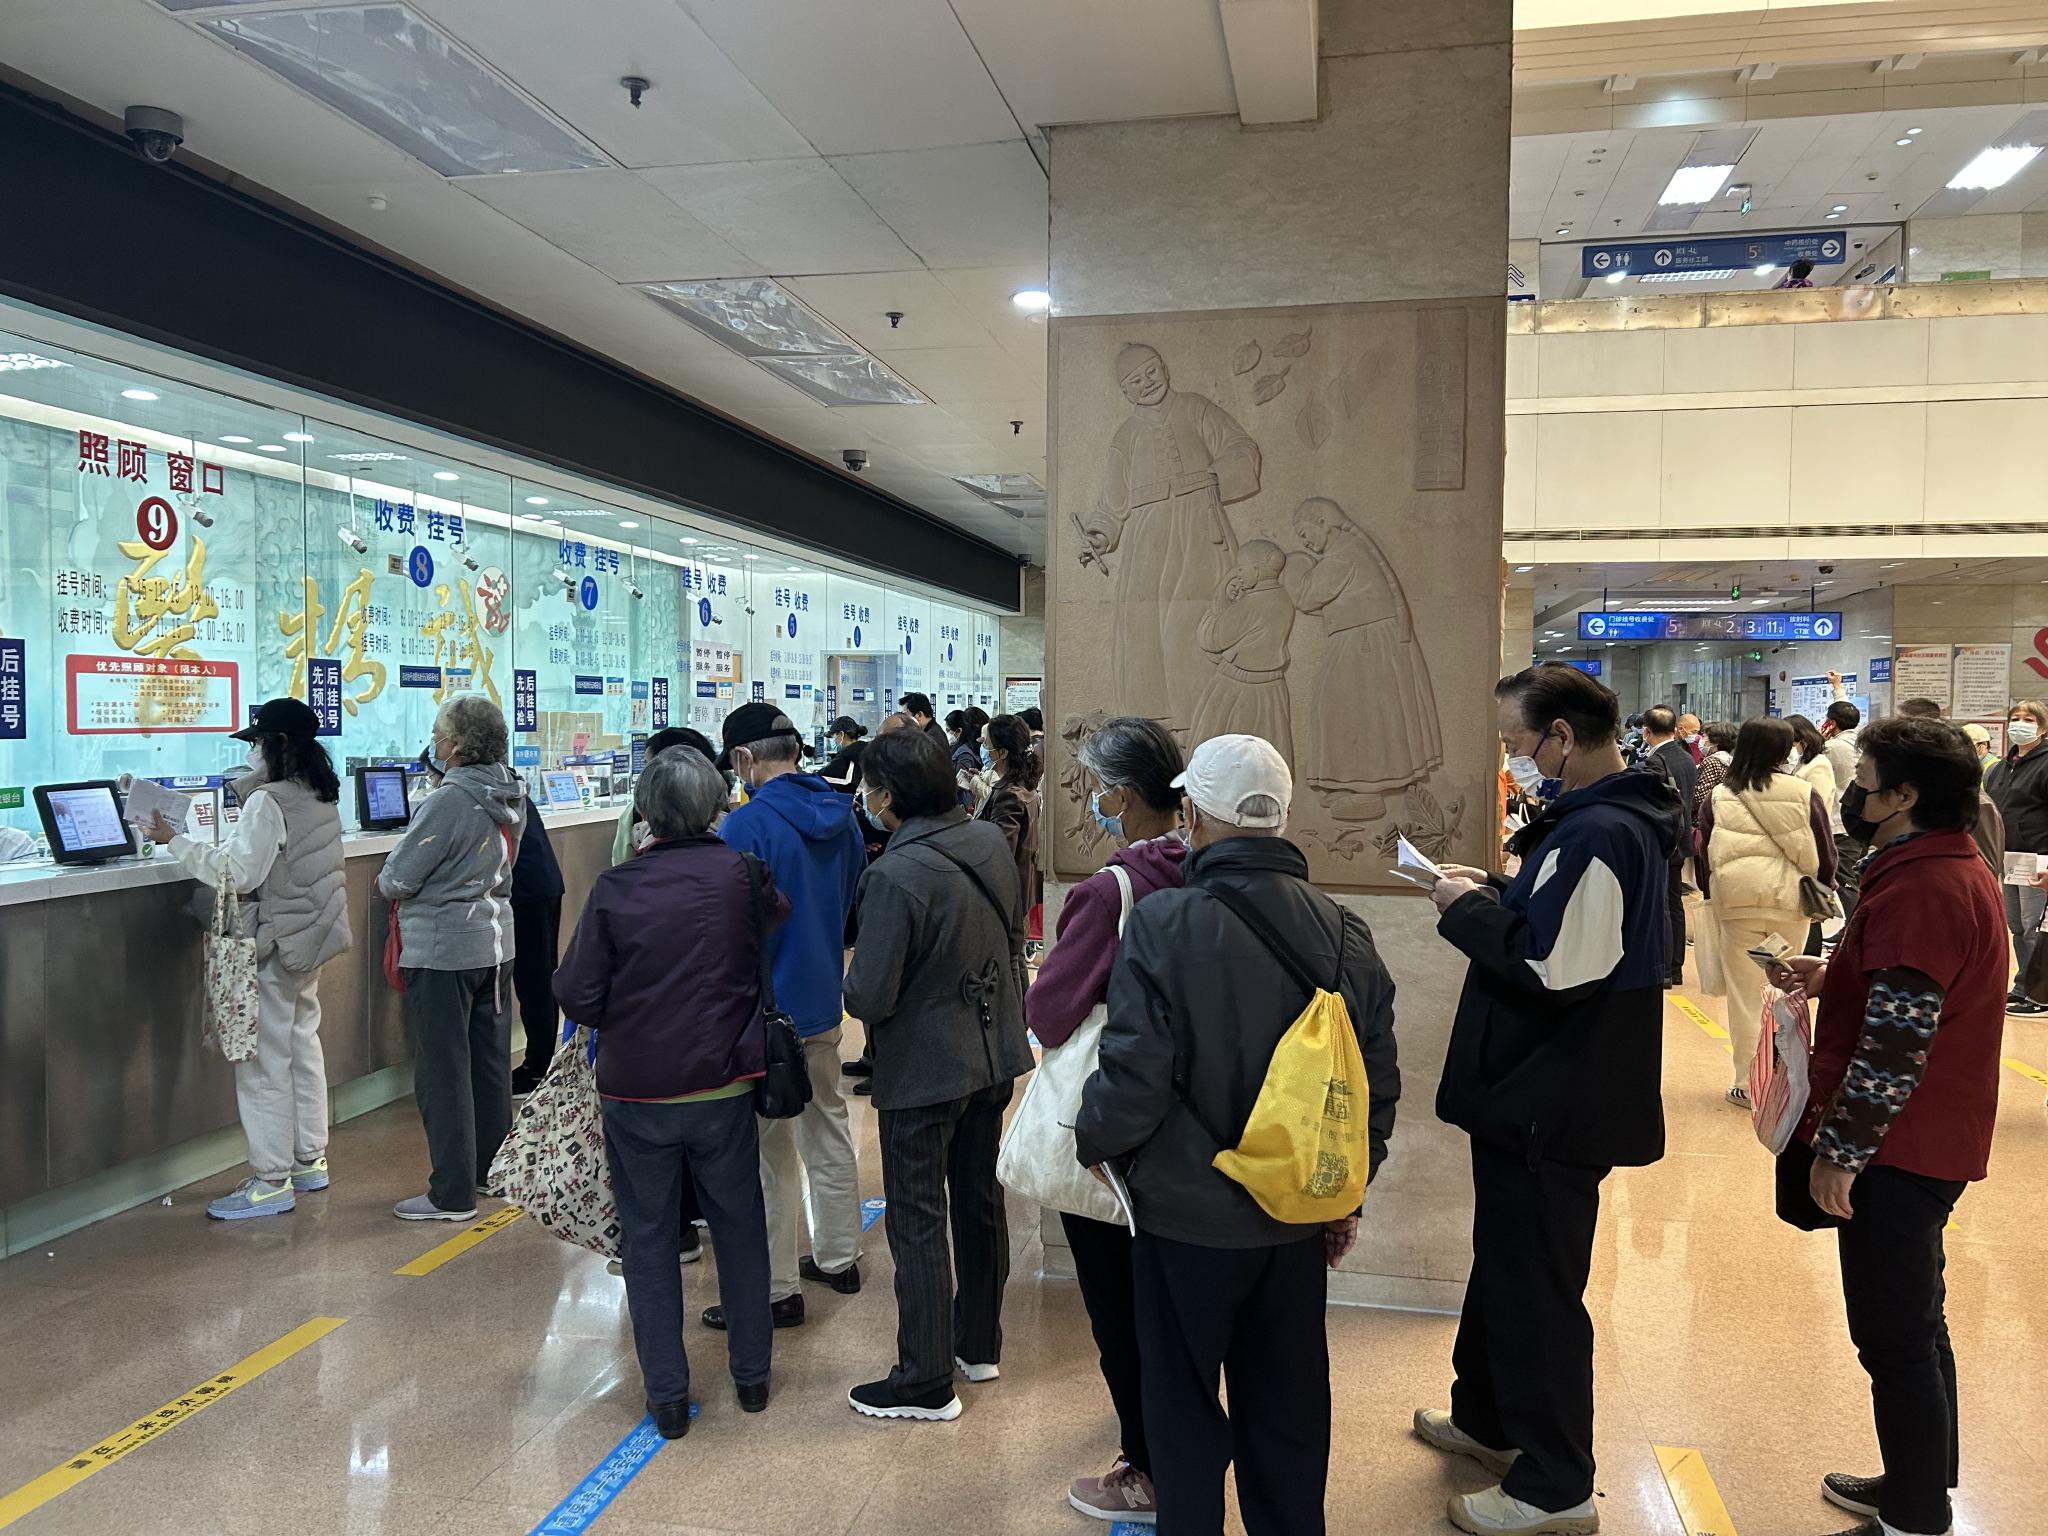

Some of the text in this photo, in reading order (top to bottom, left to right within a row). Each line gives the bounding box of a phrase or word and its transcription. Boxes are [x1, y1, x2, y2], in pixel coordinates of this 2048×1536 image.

[78, 429, 225, 496] 照顾 窗口
[149, 504, 169, 543] 9
[375, 498, 464, 544] 收费 挂号
[415, 551, 428, 582] 8
[559, 539, 620, 575] 收费 挂号
[584, 581, 594, 605] 7
[682, 567, 727, 597] 挂号 收费
[776, 587, 808, 612] 挂号 收费
[702, 602, 710, 623] 6
[1669, 620, 1678, 633] 5
[1726, 621, 1735, 633] 2
[1747, 621, 1755, 633] 3
[1767, 621, 1777, 633] 11
[696, 648, 711, 658] 暂停
[715, 650, 731, 660] 暂停
[96, 661, 217, 675] 优先照顾对象（限本人）
[696, 661, 711, 671] 服务
[715, 663, 731, 673] 服务
[0, 649, 20, 729] 后挂号
[327, 667, 339, 729] 后挂号
[516, 676, 525, 725] 先预检
[526, 676, 535, 725] 后挂号
[104, 1439, 139, 1460] Please
[136, 1425, 161, 1442] Wait
[160, 1408, 194, 1428] Behind
[193, 1397, 212, 1411] The
